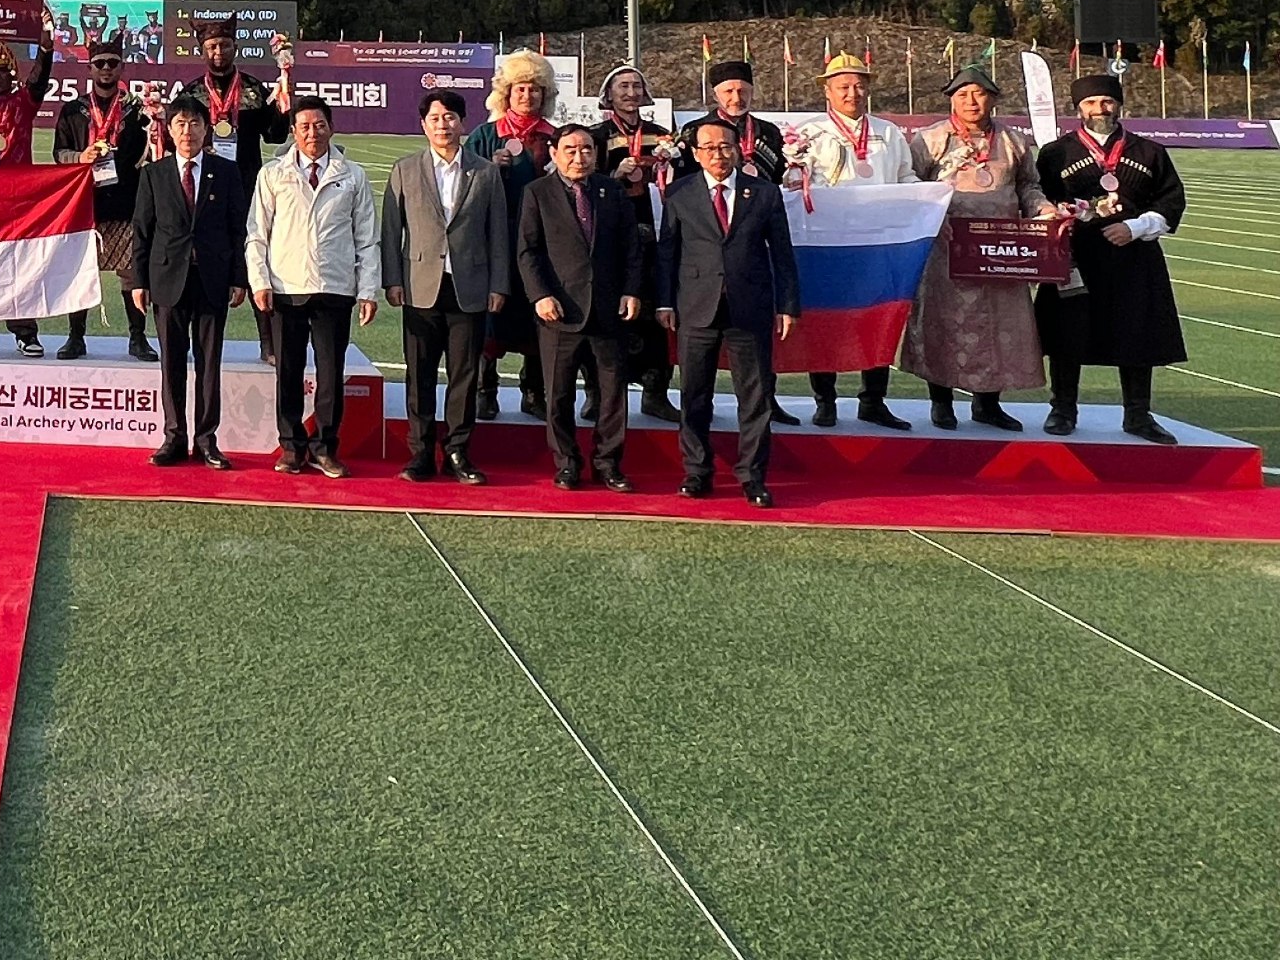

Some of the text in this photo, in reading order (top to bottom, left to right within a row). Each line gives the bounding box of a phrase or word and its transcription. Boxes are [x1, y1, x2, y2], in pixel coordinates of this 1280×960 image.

[194, 9, 255, 20] Indonesa(A)
[258, 10, 277, 20] (ID)
[241, 47, 264, 58] (RU)
[43, 78, 79, 102] 25
[979, 245, 1038, 257] TEAM 3rd
[23, 385, 158, 412] 세계궁도대회
[16, 415, 76, 432] Archery
[79, 417, 124, 431] World
[128, 419, 157, 435] Cup
